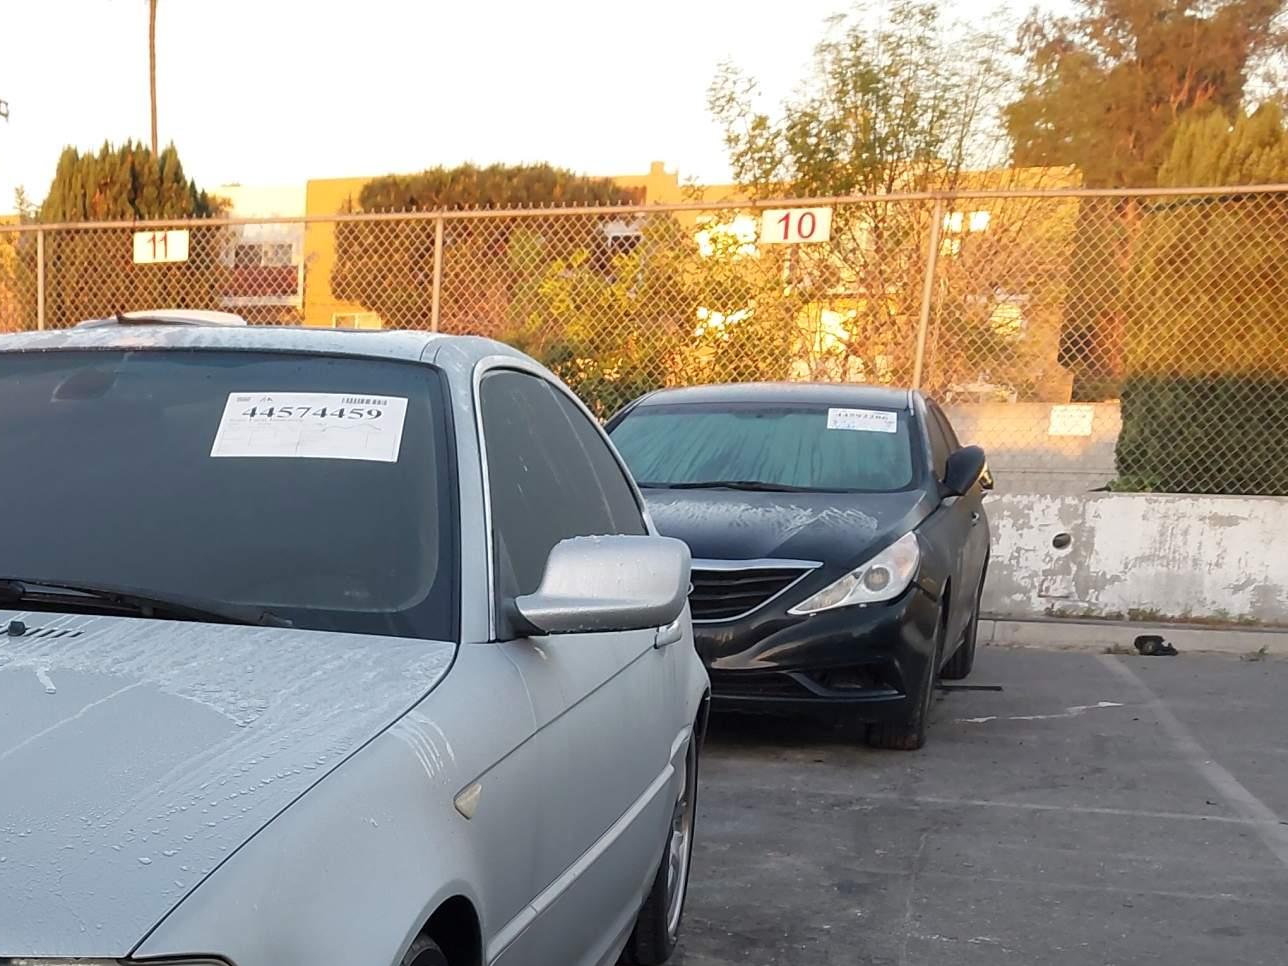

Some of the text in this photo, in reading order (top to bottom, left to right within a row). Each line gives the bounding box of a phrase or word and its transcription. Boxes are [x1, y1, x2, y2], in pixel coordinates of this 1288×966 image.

[777, 211, 817, 241] 10
[146, 231, 168, 260] 11
[242, 405, 383, 421] 44574459
